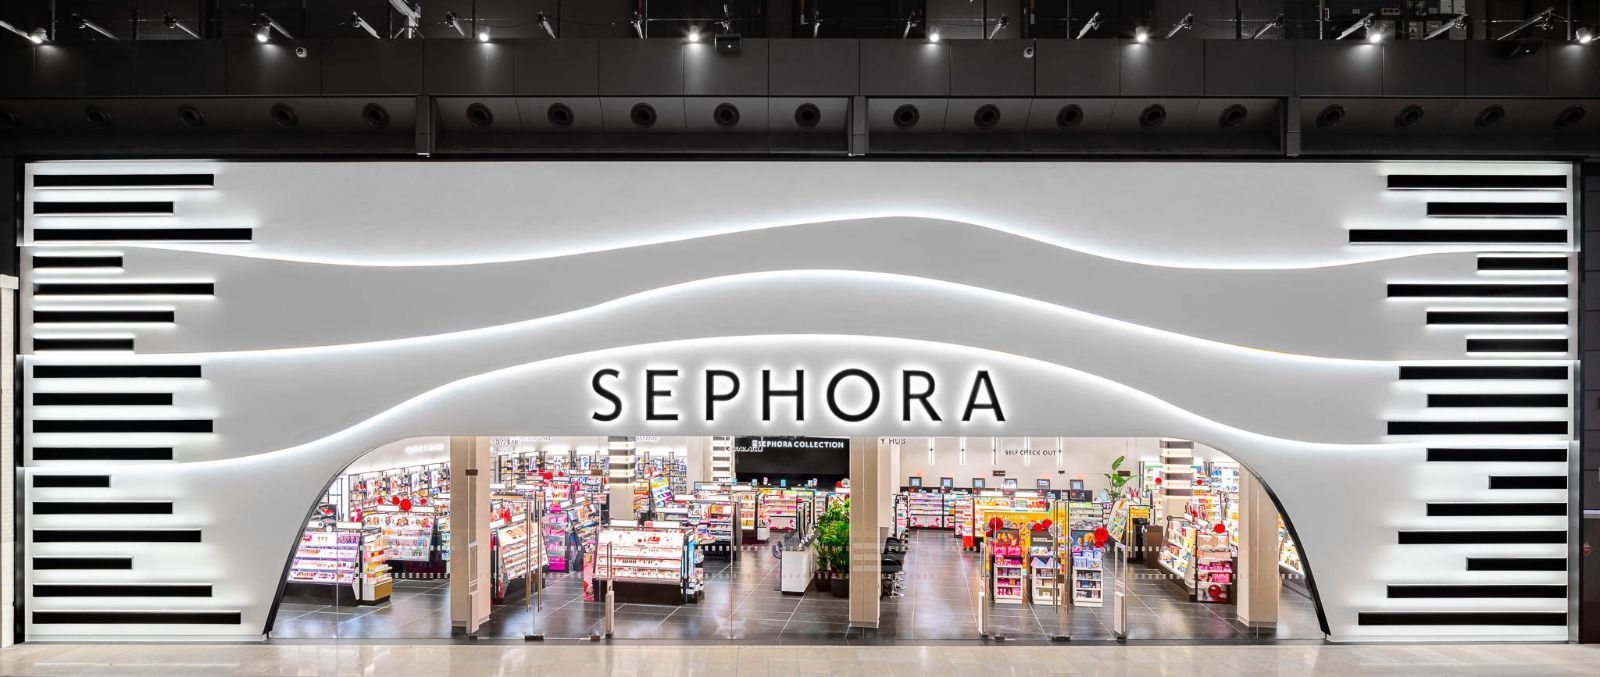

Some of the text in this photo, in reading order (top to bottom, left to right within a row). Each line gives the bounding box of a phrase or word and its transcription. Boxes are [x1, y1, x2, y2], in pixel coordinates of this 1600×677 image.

[592, 369, 1006, 422] SEPHORA
[758, 440, 844, 449] SEPHORA COLLECTION
